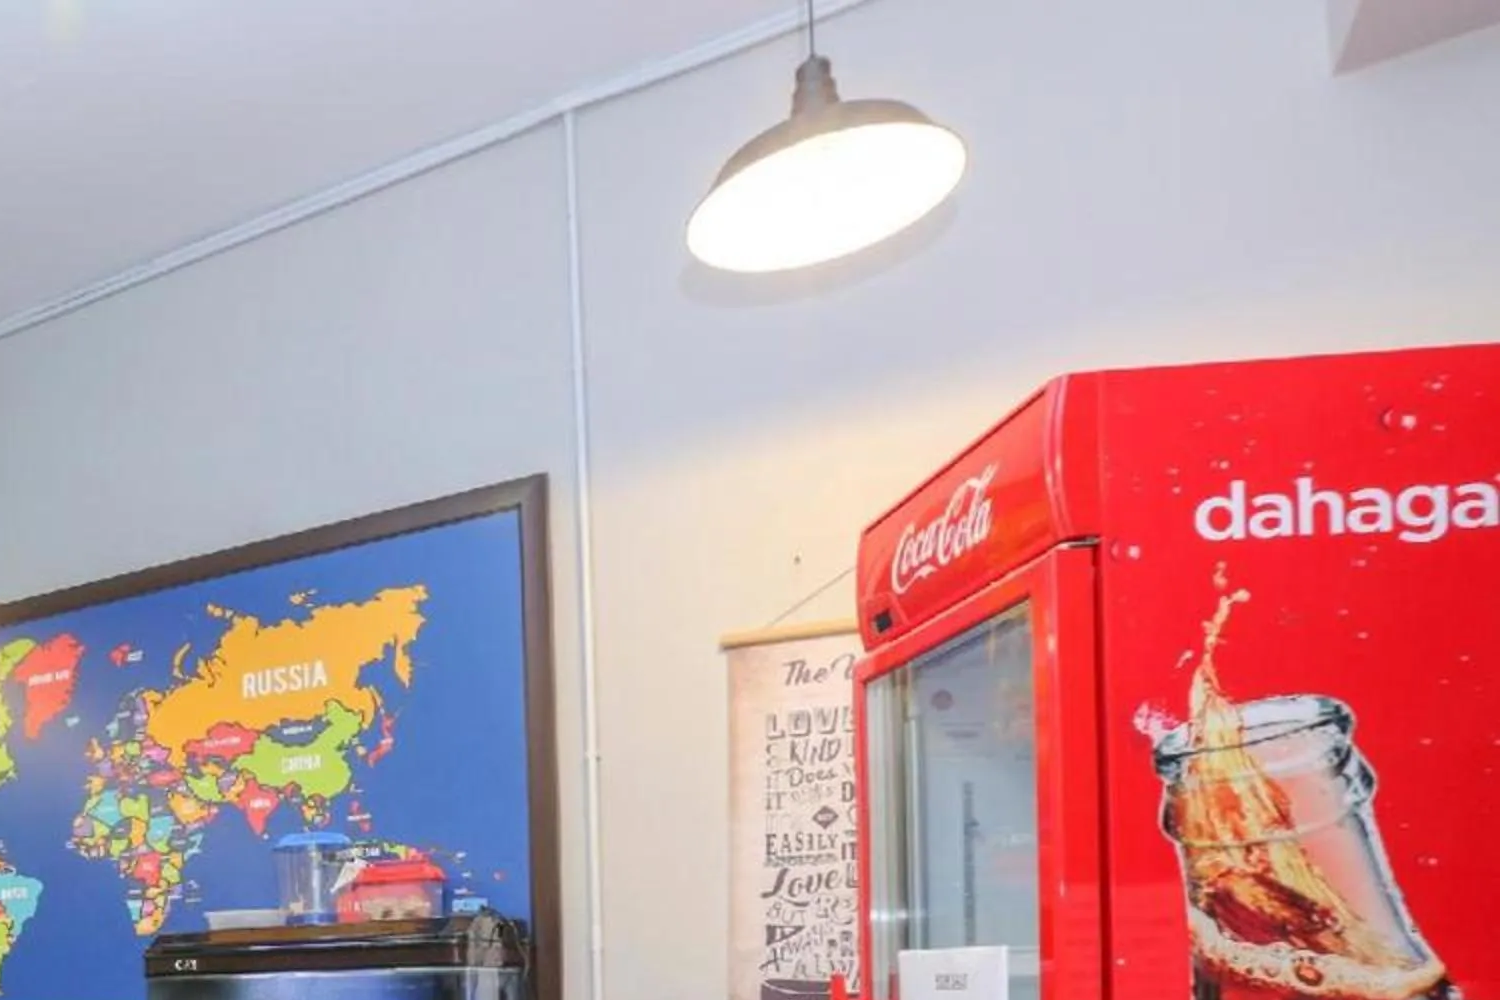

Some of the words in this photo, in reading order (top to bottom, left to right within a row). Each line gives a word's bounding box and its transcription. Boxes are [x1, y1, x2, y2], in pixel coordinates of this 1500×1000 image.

[1194, 477, 1500, 543] dahaga
[242, 660, 329, 699] RUSSIA
[782, 659, 828, 686] The
[281, 755, 323, 775] CHINA
[790, 738, 841, 765] KIND
[786, 766, 838, 787] Does
[765, 831, 839, 856] EASILY
[761, 867, 843, 907] Love
